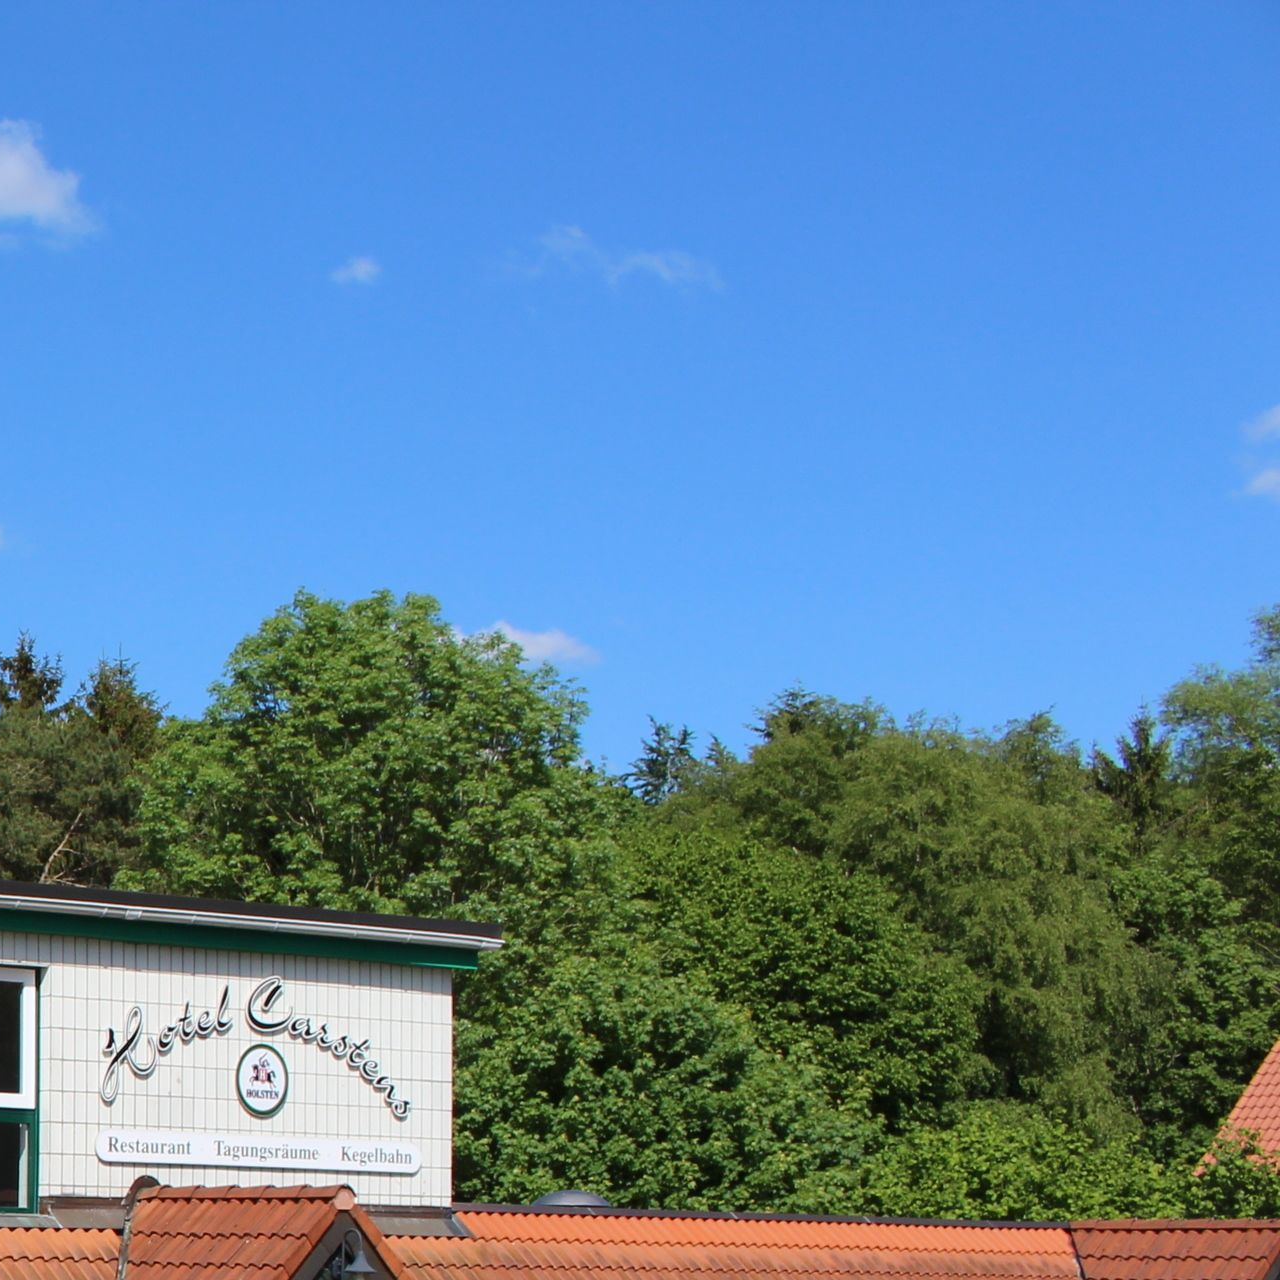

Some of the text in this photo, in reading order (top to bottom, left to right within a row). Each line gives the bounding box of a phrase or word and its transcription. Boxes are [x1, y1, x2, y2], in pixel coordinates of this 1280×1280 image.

[101, 975, 411, 1120] Hotel Carstens
[246, 1089, 279, 1099] HOLSTEN
[108, 1136, 412, 1166] Restaurant Tagungsräume Kegelbahn
